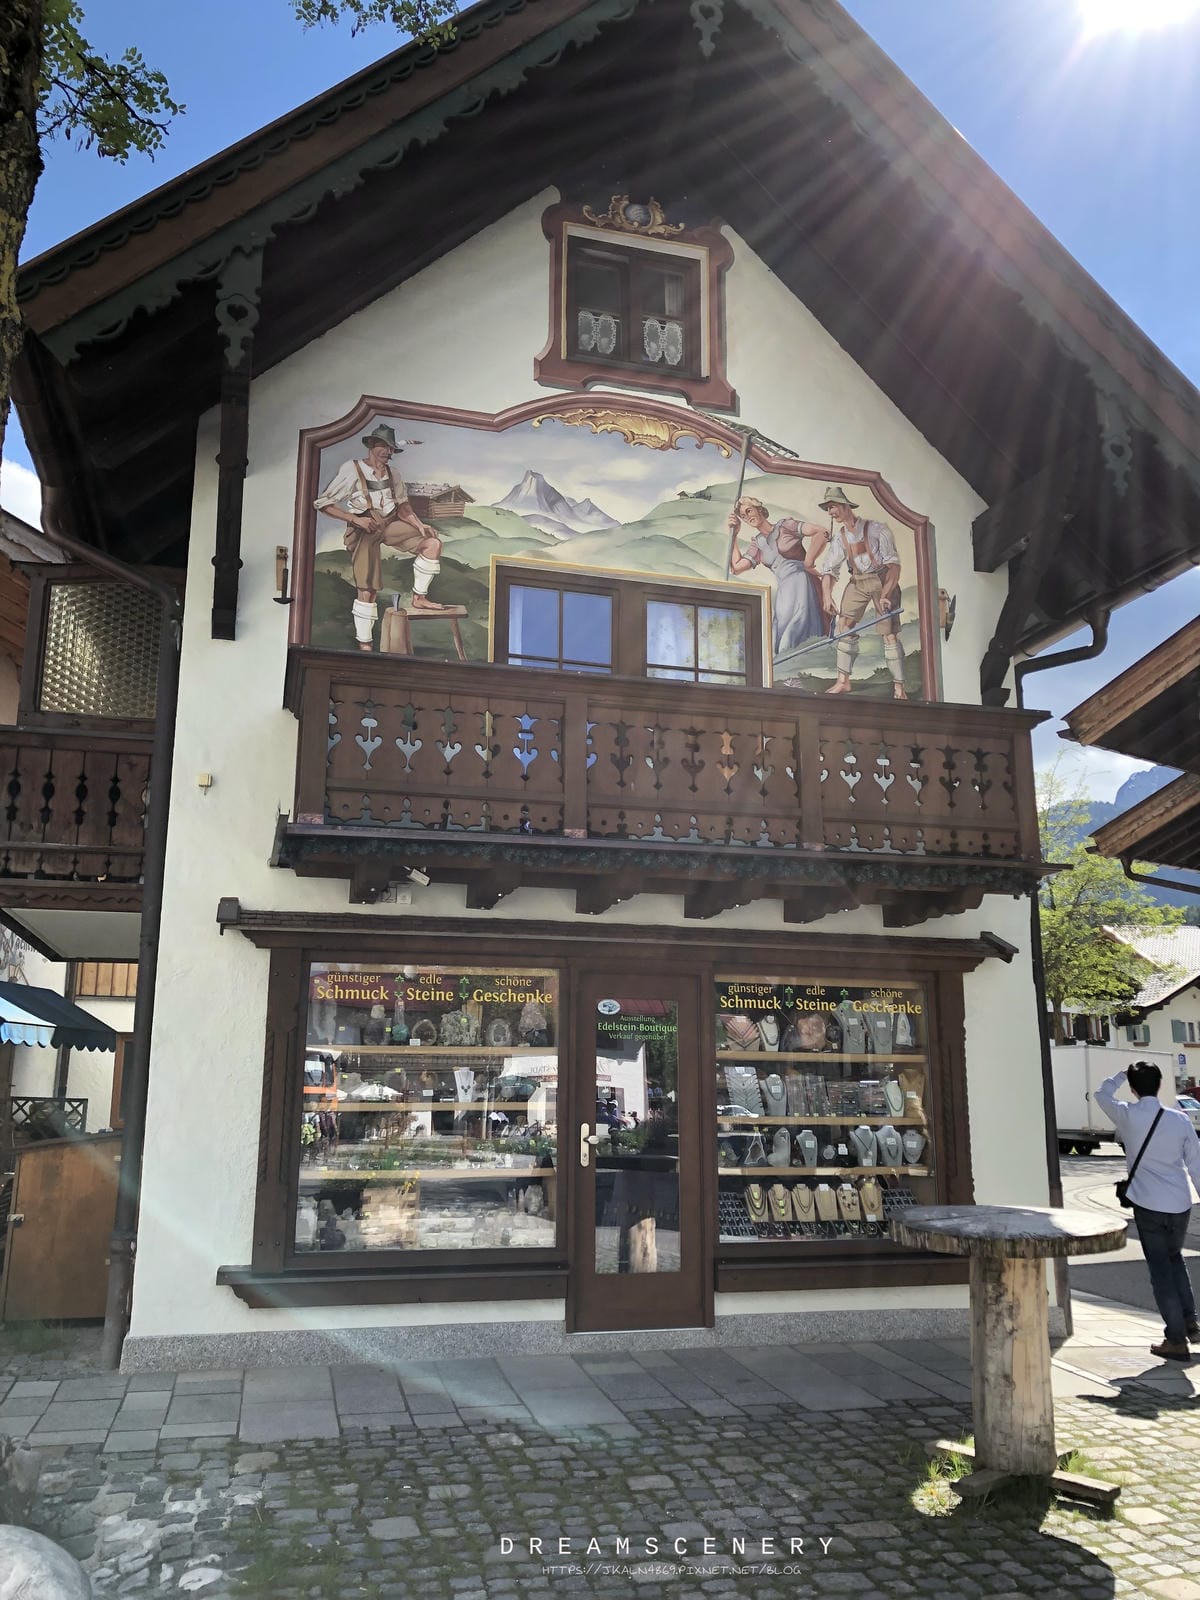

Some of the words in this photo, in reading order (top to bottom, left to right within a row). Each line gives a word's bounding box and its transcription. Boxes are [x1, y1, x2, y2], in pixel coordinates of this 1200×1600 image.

[327, 973, 381, 985] günstiger
[420, 974, 442, 985] edle
[495, 976, 532, 987] schöne
[317, 985, 389, 1000] Schmuck
[406, 988, 454, 1001] Steine
[473, 989, 552, 1004] Geschenke
[728, 984, 774, 996] günstiger
[806, 986, 826, 996] edle
[870, 988, 903, 998] schöne
[720, 995, 781, 1010] Schmuck
[796, 999, 837, 1011] Steine
[852, 1000, 922, 1014] Geschenke
[620, 1015, 656, 1023] Ausstellung
[597, 1021, 678, 1034] Edelstein-Boutique
[609, 1032, 634, 1040] Verkauf
[635, 1033, 667, 1041] gegenüber
